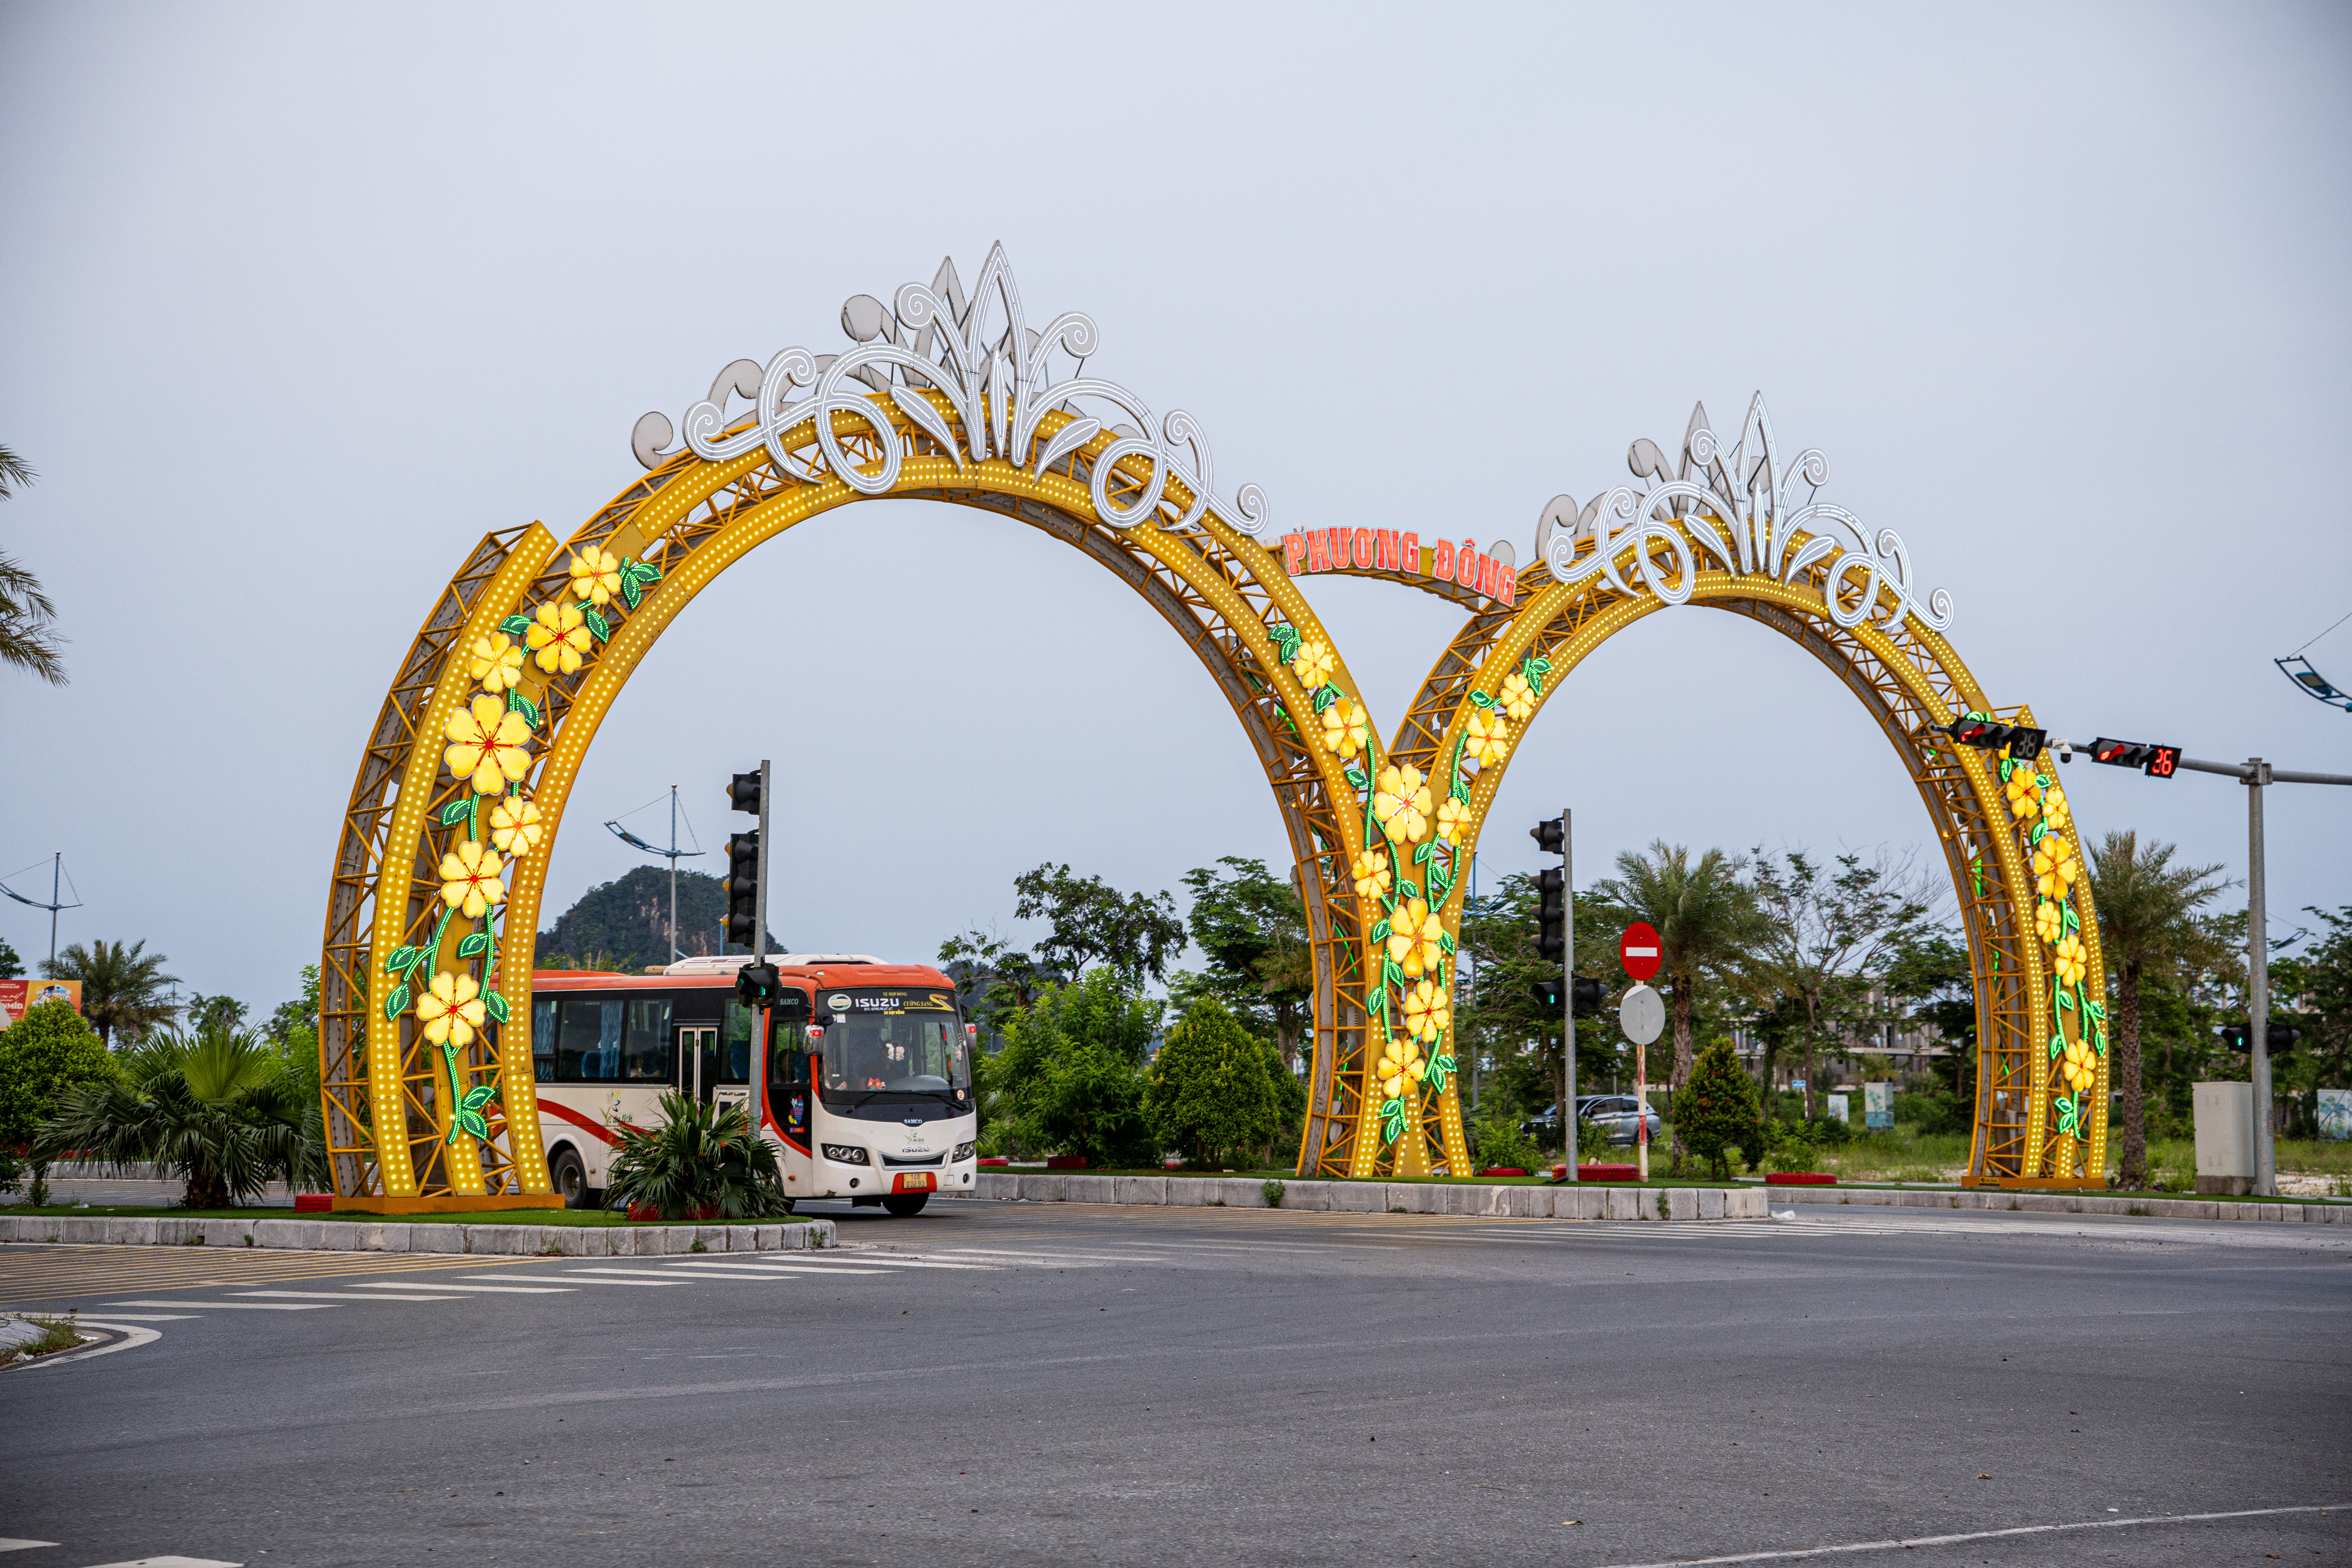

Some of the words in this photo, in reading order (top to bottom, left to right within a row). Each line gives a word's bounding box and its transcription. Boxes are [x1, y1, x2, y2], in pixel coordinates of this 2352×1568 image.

[1283, 526, 1420, 577] PHƯƠNG
[1434, 537, 1516, 607] ĐÔNG
[2152, 748, 2173, 775] 26
[855, 998, 900, 1007] ISUZU
